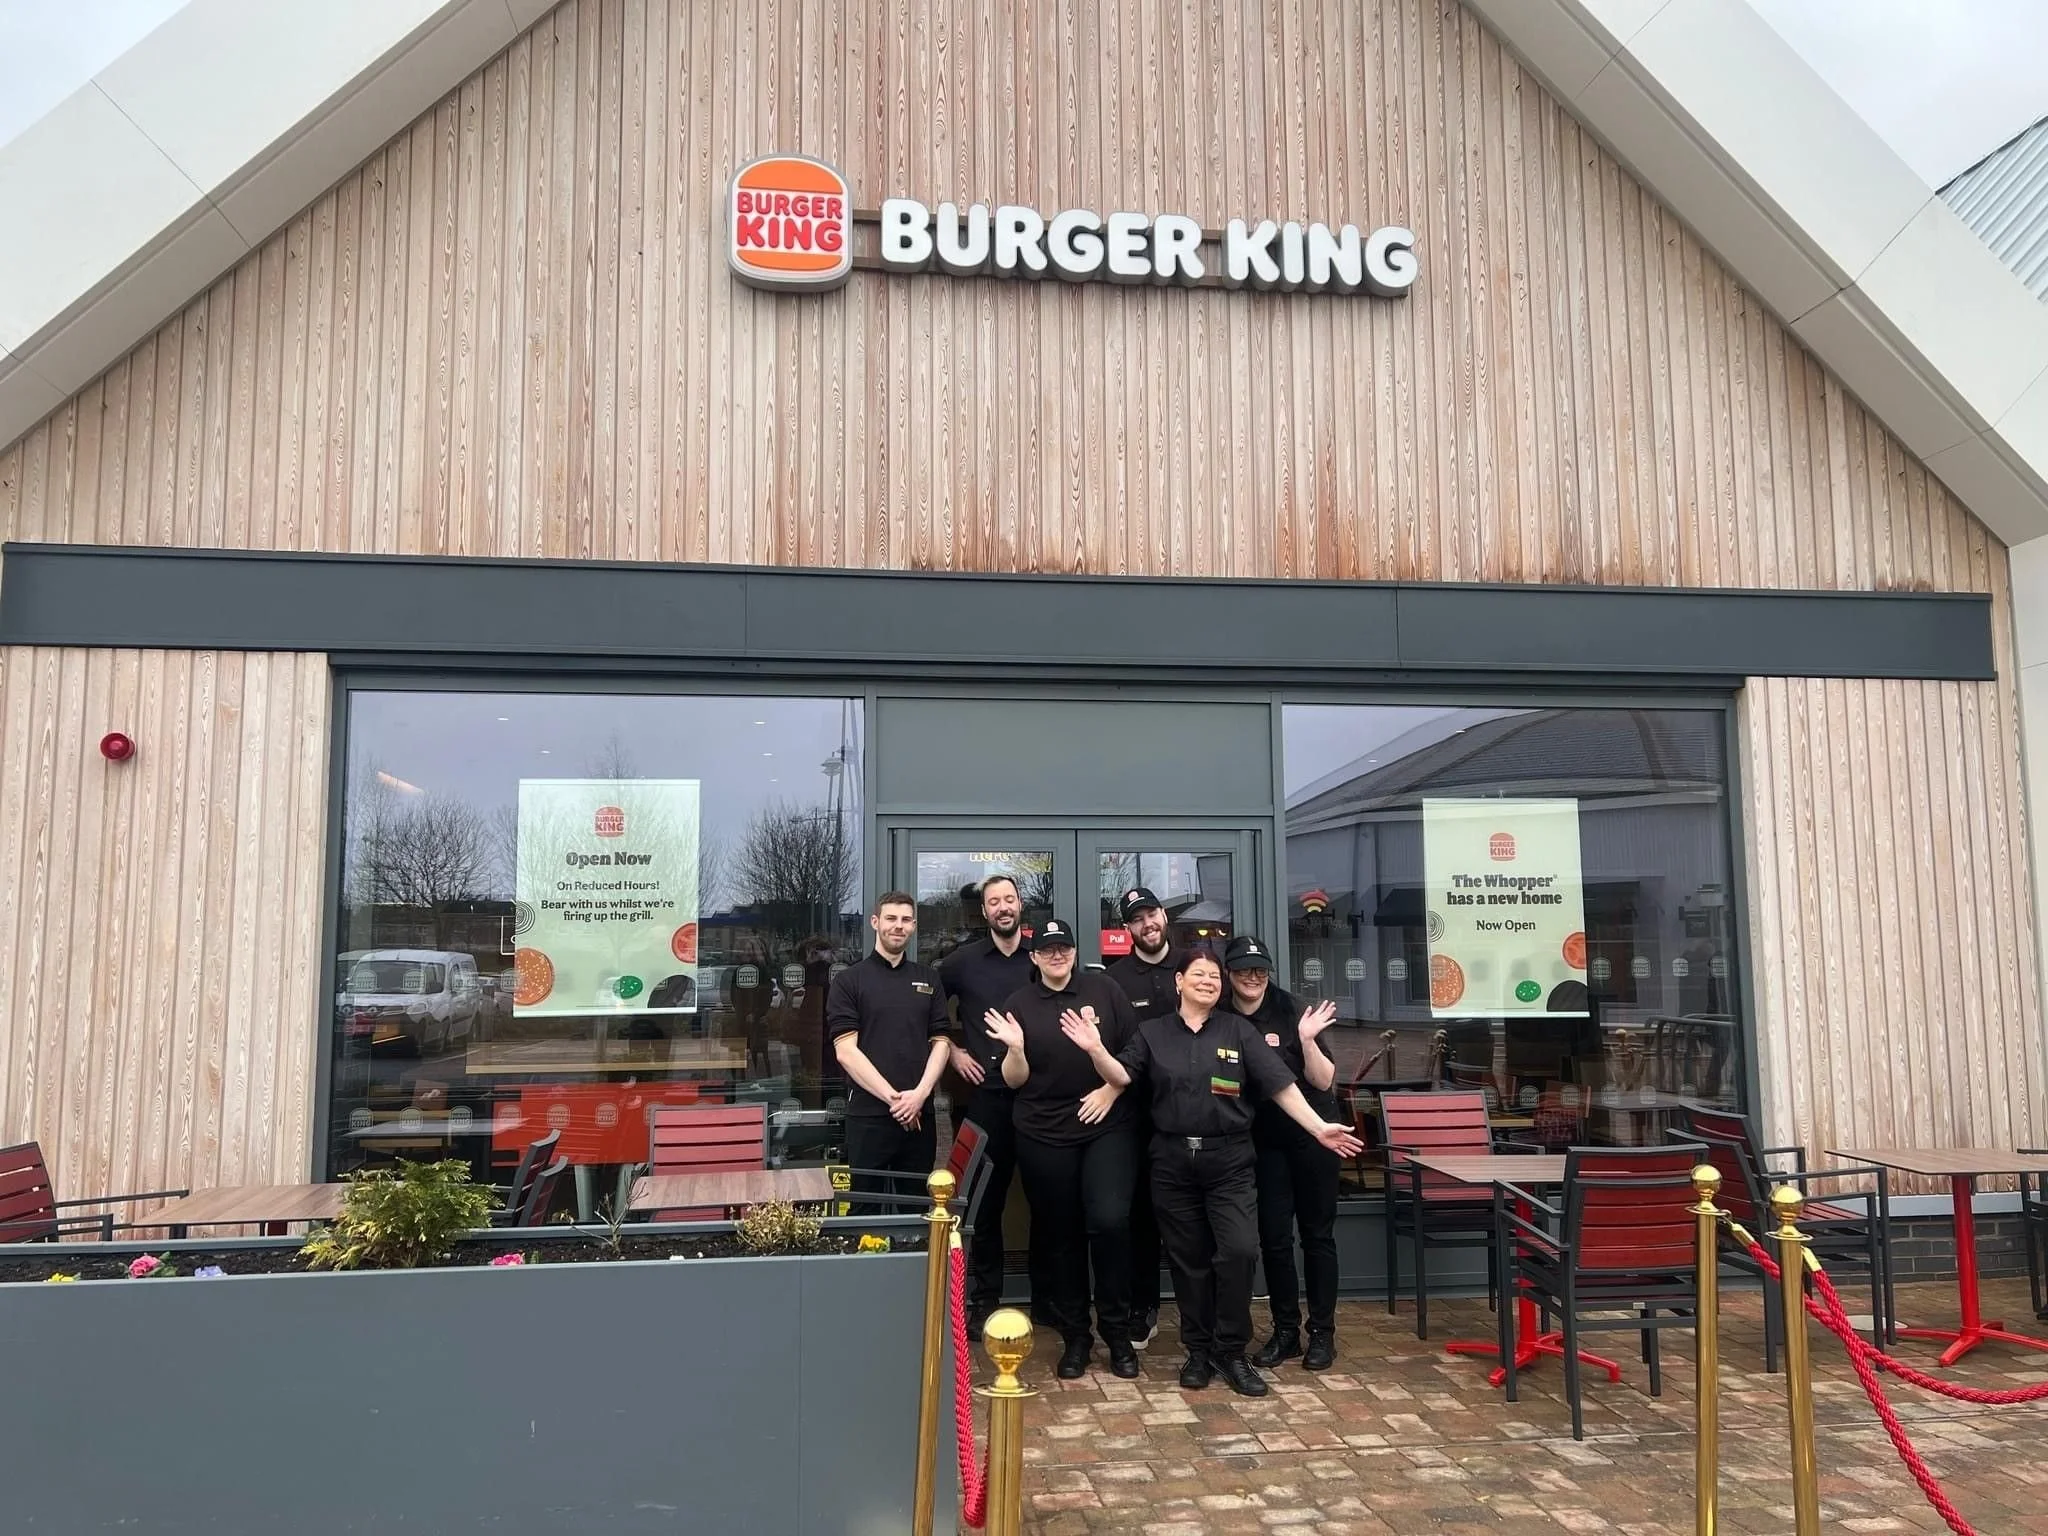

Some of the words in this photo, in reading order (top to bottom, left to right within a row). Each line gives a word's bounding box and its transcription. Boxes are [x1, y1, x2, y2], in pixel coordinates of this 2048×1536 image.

[737, 192, 842, 219] BURGER
[737, 215, 842, 251] KING
[881, 197, 1205, 281] BURGER
[1226, 216, 1419, 290] KING
[595, 822, 624, 831] KING
[1490, 847, 1515, 856] KING
[566, 852, 611, 869] Open
[614, 852, 652, 866] Now
[557, 881, 572, 890] On
[574, 881, 621, 890] Reduced
[624, 881, 660, 890] Hours!
[1452, 874, 1482, 887] The
[541, 900, 566, 909] Bear
[569, 899, 592, 909] with
[595, 901, 607, 909] us
[610, 899, 641, 908] whilst
[644, 899, 674, 908] we're
[1447, 892, 1474, 905] has
[1476, 894, 1485, 904] a
[1488, 894, 1518, 904] new
[1521, 891, 1562, 904] home
[564, 911, 592, 922] firing
[594, 912, 607, 922] up
[610, 911, 628, 920] the
[630, 910, 654, 922] grill.
[1476, 920, 1502, 930] Now
[1505, 920, 1536, 932] Open
[1109, 935, 1125, 943] Pull
